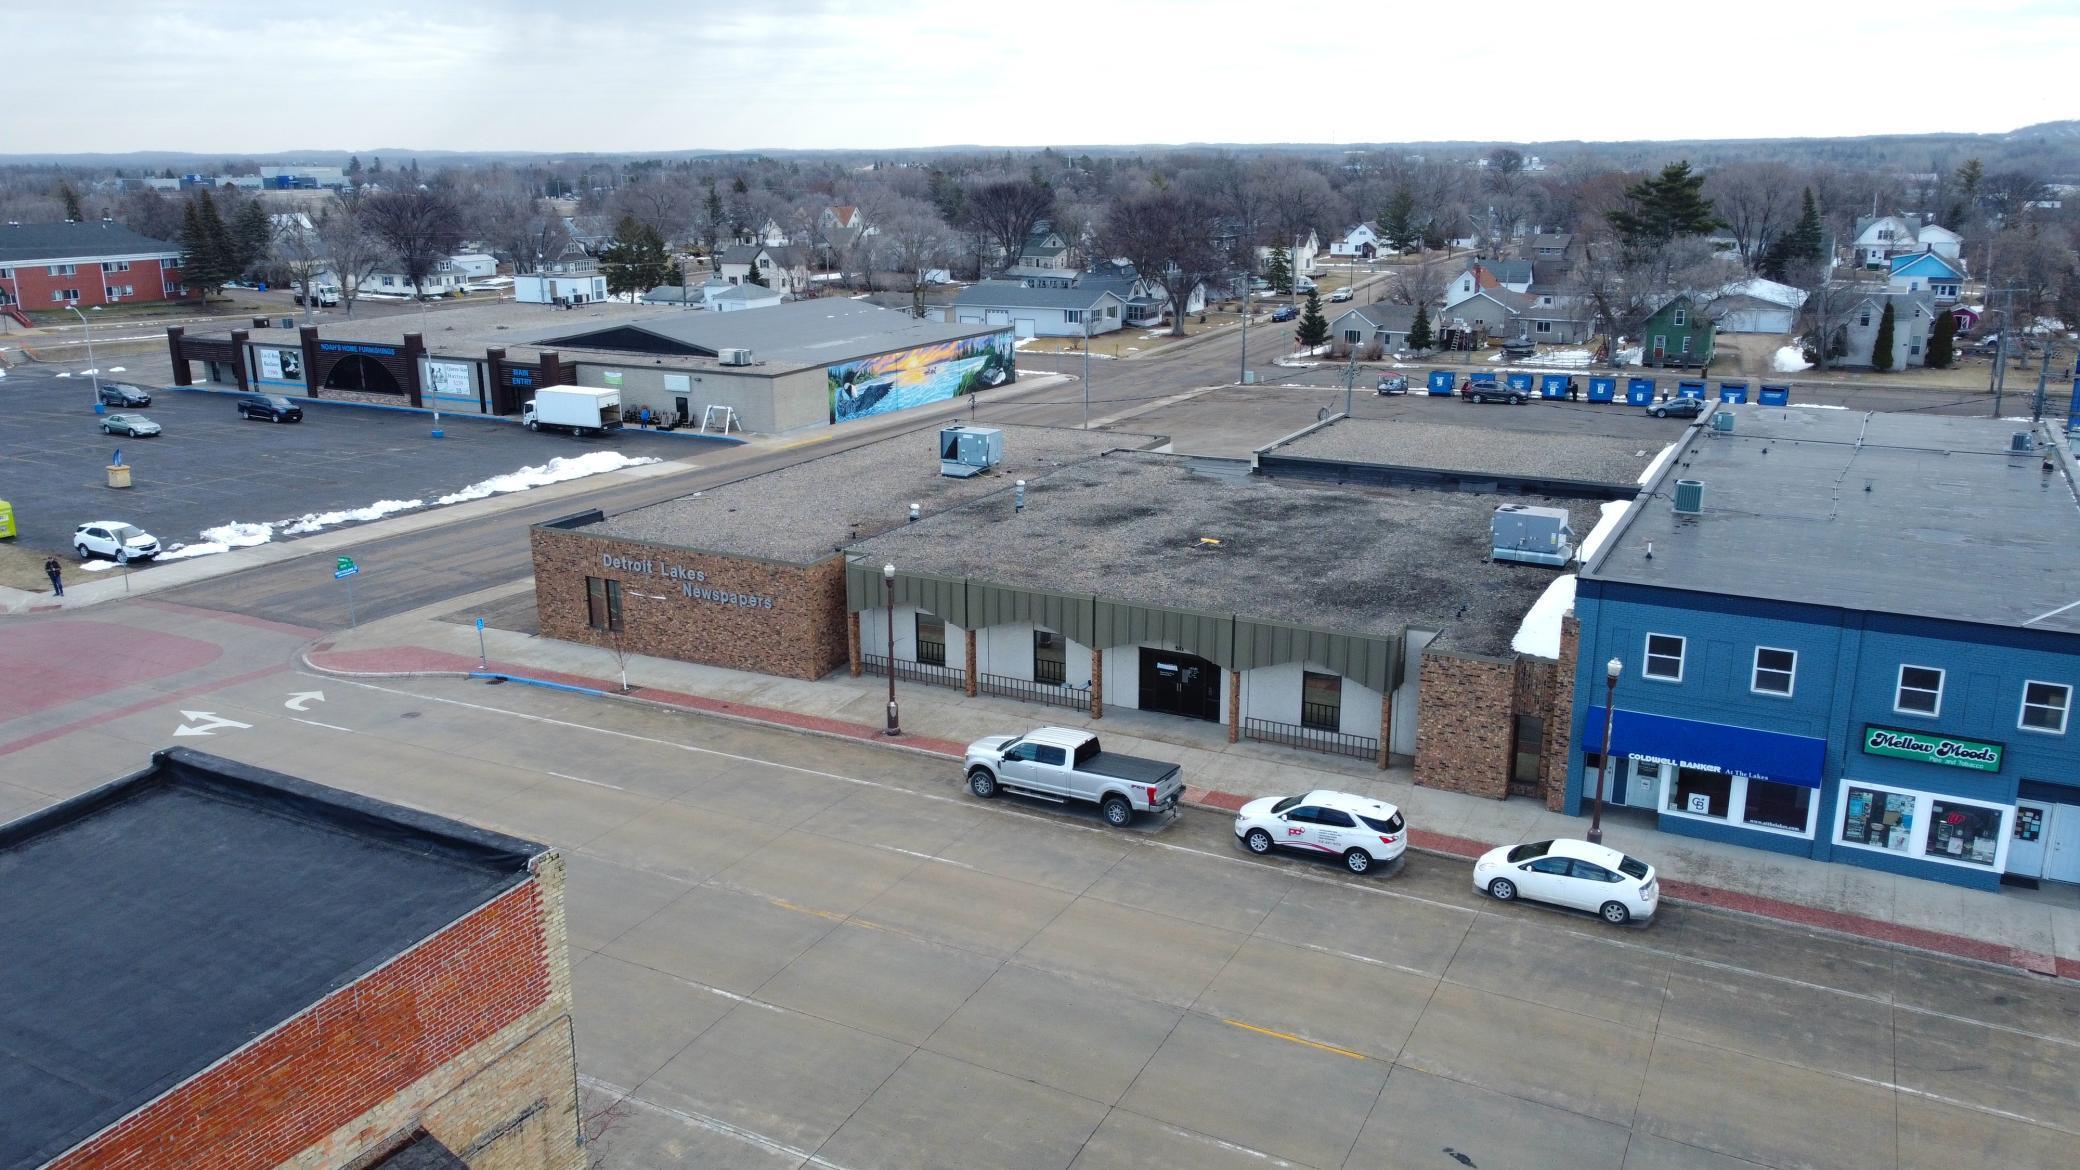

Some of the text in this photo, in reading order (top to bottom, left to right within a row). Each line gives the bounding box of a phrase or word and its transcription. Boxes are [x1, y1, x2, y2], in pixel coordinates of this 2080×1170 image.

[512, 377, 532, 385] ENTRY
[602, 553, 705, 582] Detroit Lakes
[682, 582, 773, 609] Newspapers
[1870, 731, 1997, 763] Mellow Moods
[1628, 752, 1677, 767] COLDWELL
[1680, 760, 1722, 773] BANKER
[1735, 769, 1747, 778] The
[1748, 772, 1769, 781] Lakes
